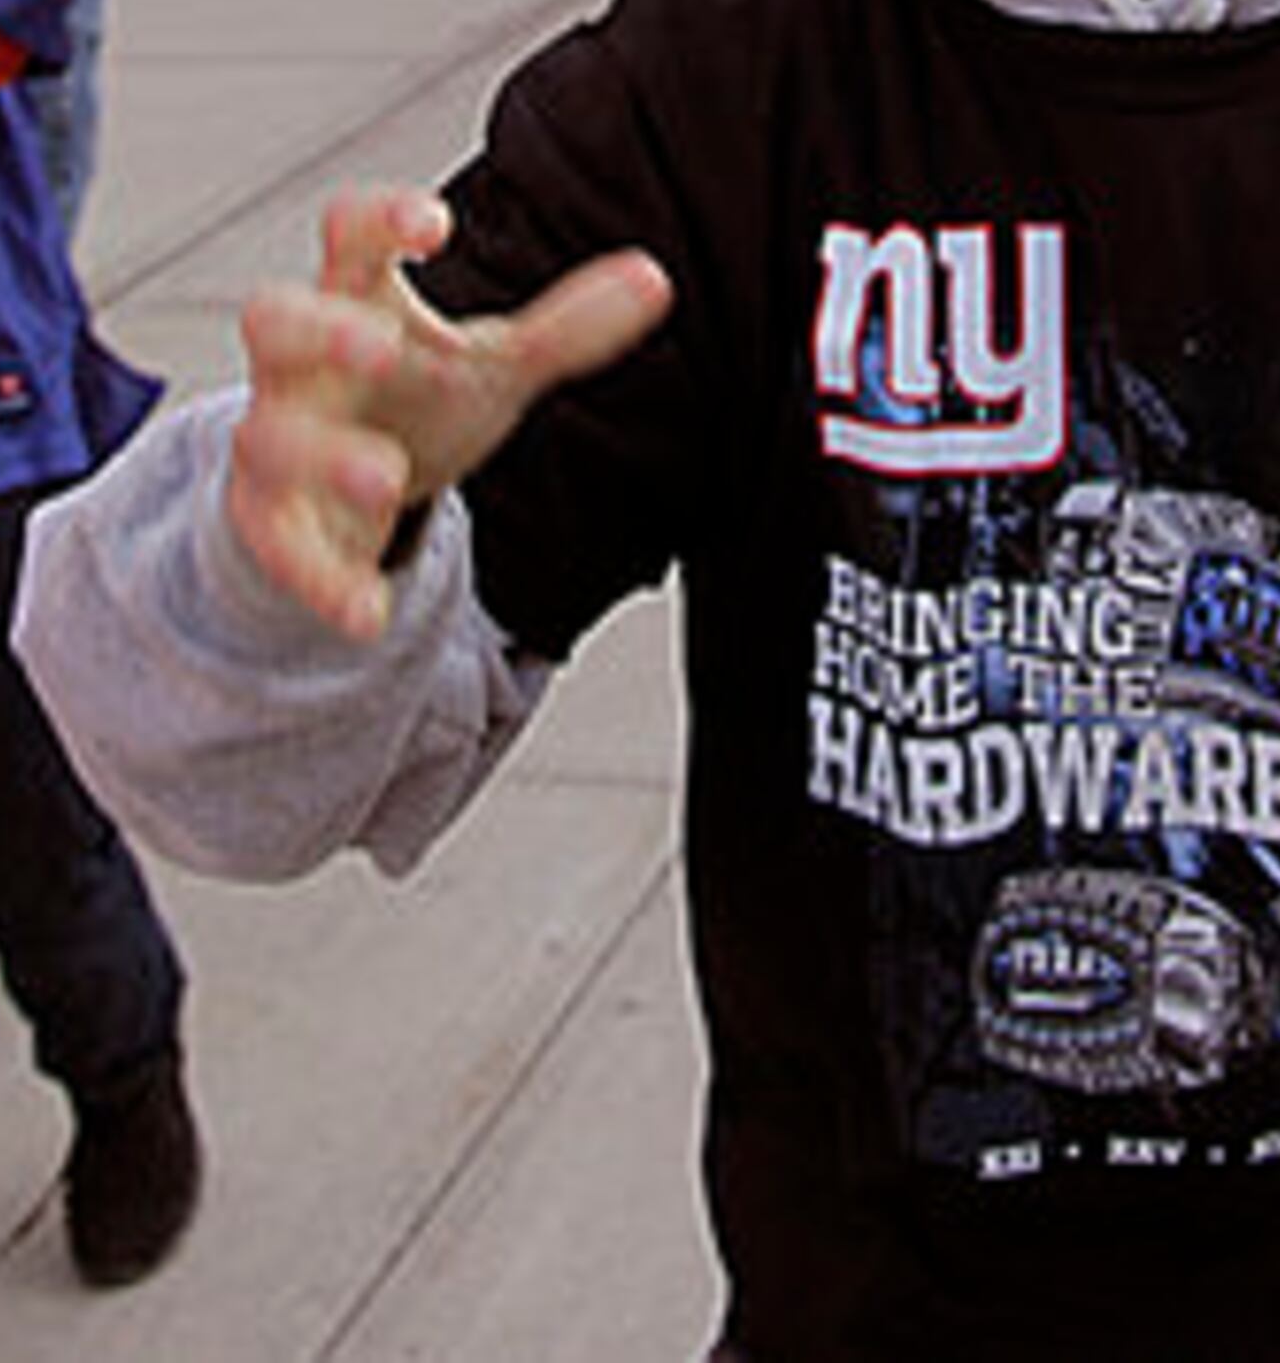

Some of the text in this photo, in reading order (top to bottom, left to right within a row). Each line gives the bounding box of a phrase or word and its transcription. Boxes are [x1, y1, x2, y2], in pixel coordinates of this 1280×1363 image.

[825, 554, 1136, 660] BRINGING
[813, 621, 1160, 730] HOME THE
